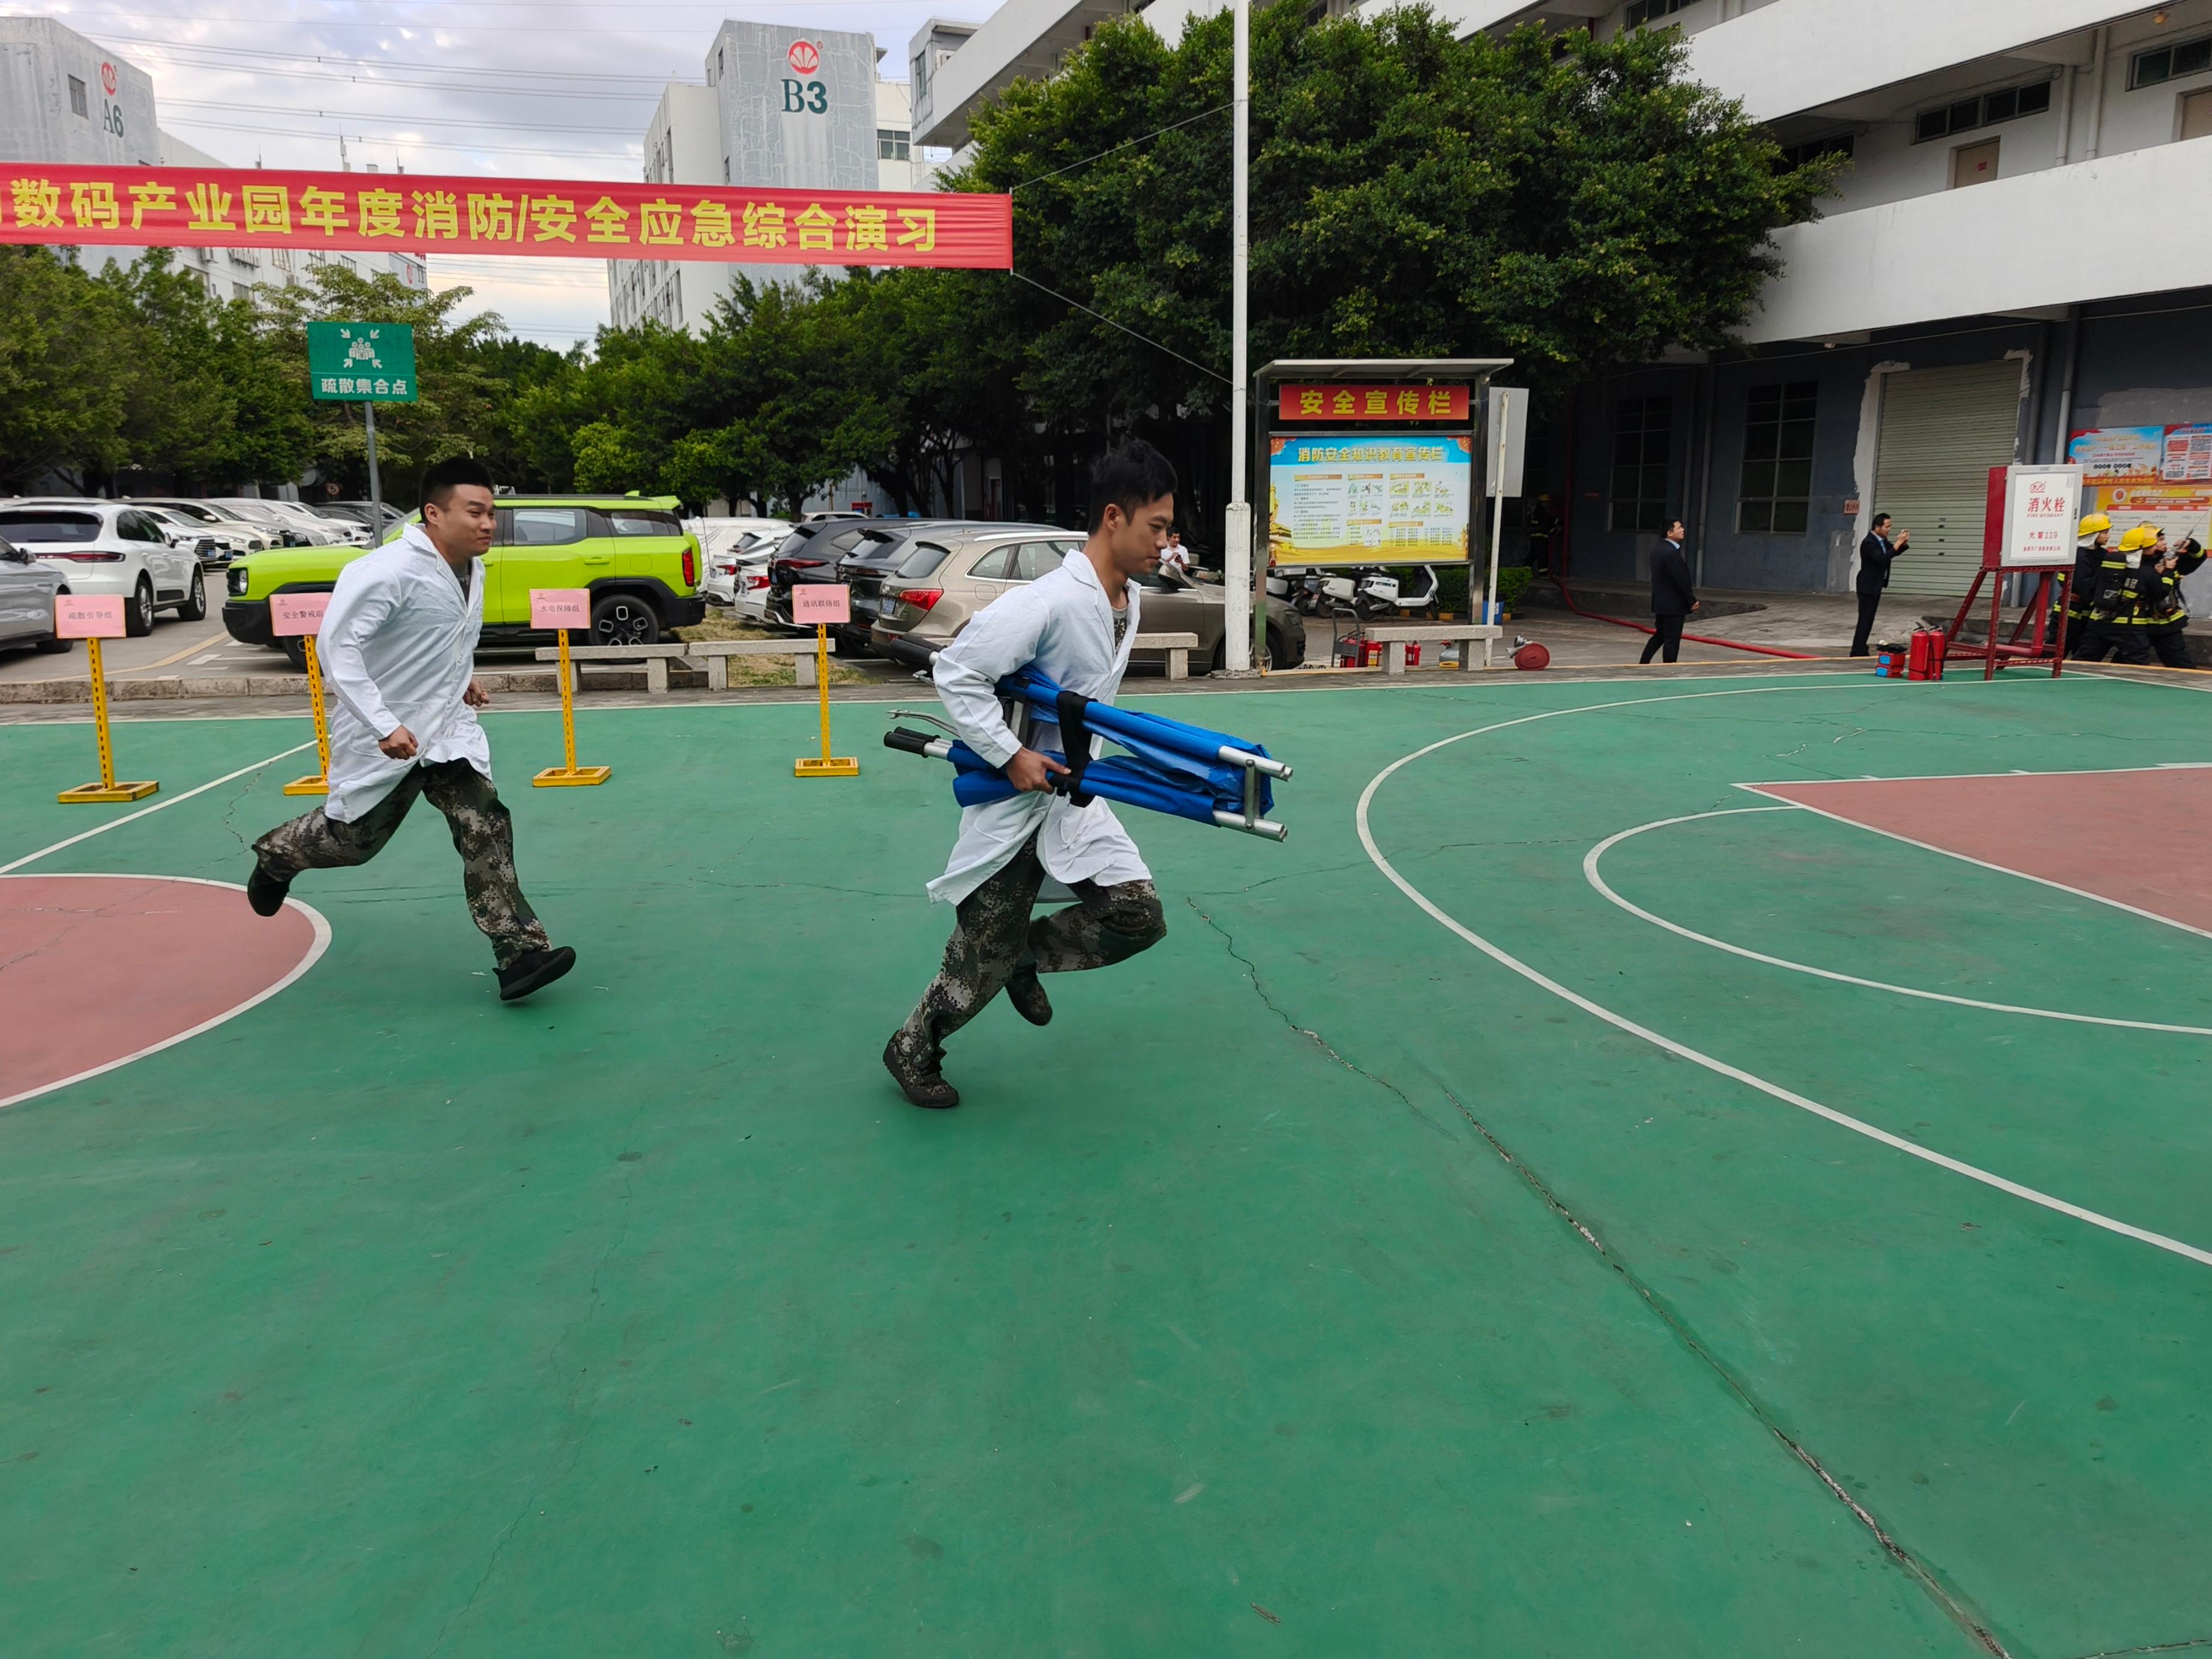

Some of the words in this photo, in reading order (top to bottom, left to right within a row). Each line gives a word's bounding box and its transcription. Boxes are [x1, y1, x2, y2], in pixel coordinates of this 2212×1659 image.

[781, 79, 828, 114] B3
[103, 98, 124, 138] A6
[0, 178, 936, 253] 数码产业园年度消防/安全应急综合演习
[321, 378, 407, 396] 疏散集合点
[1300, 390, 1452, 415] 安全宣传栏
[1297, 446, 1444, 462] 消防安全知识教育宣传栏
[2028, 497, 2065, 513] 消火栓
[68, 610, 112, 619] 疏散引导组
[540, 604, 580, 613] 水电保障组
